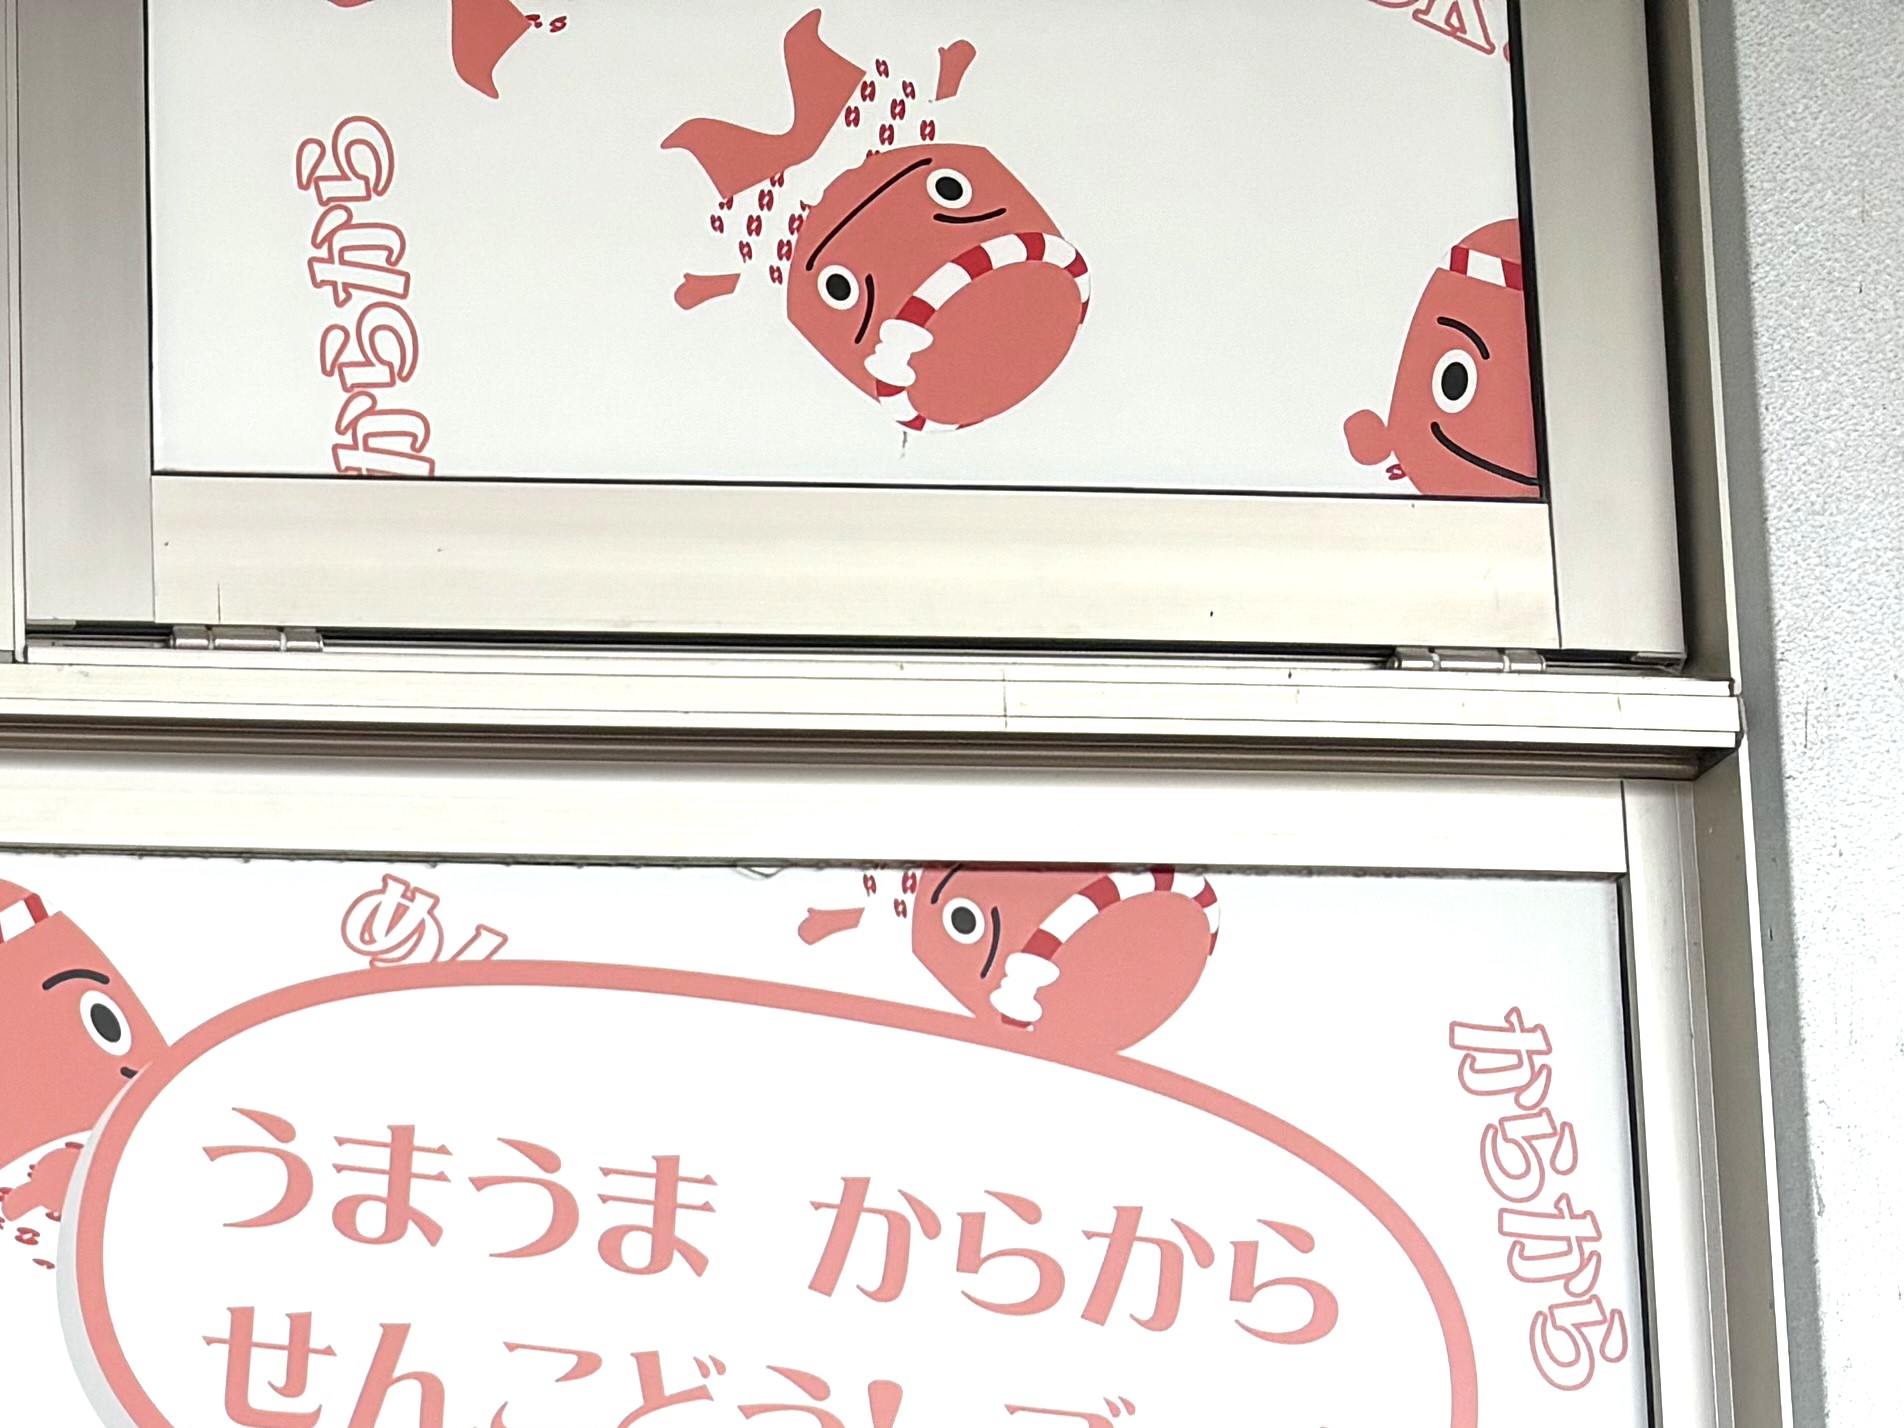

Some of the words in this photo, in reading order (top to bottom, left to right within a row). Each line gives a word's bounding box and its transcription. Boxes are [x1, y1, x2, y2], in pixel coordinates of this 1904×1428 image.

[201, 1107, 718, 1277] うまうま
[807, 1176, 1340, 1345] からから
[1448, 1006, 1629, 1392] からから
